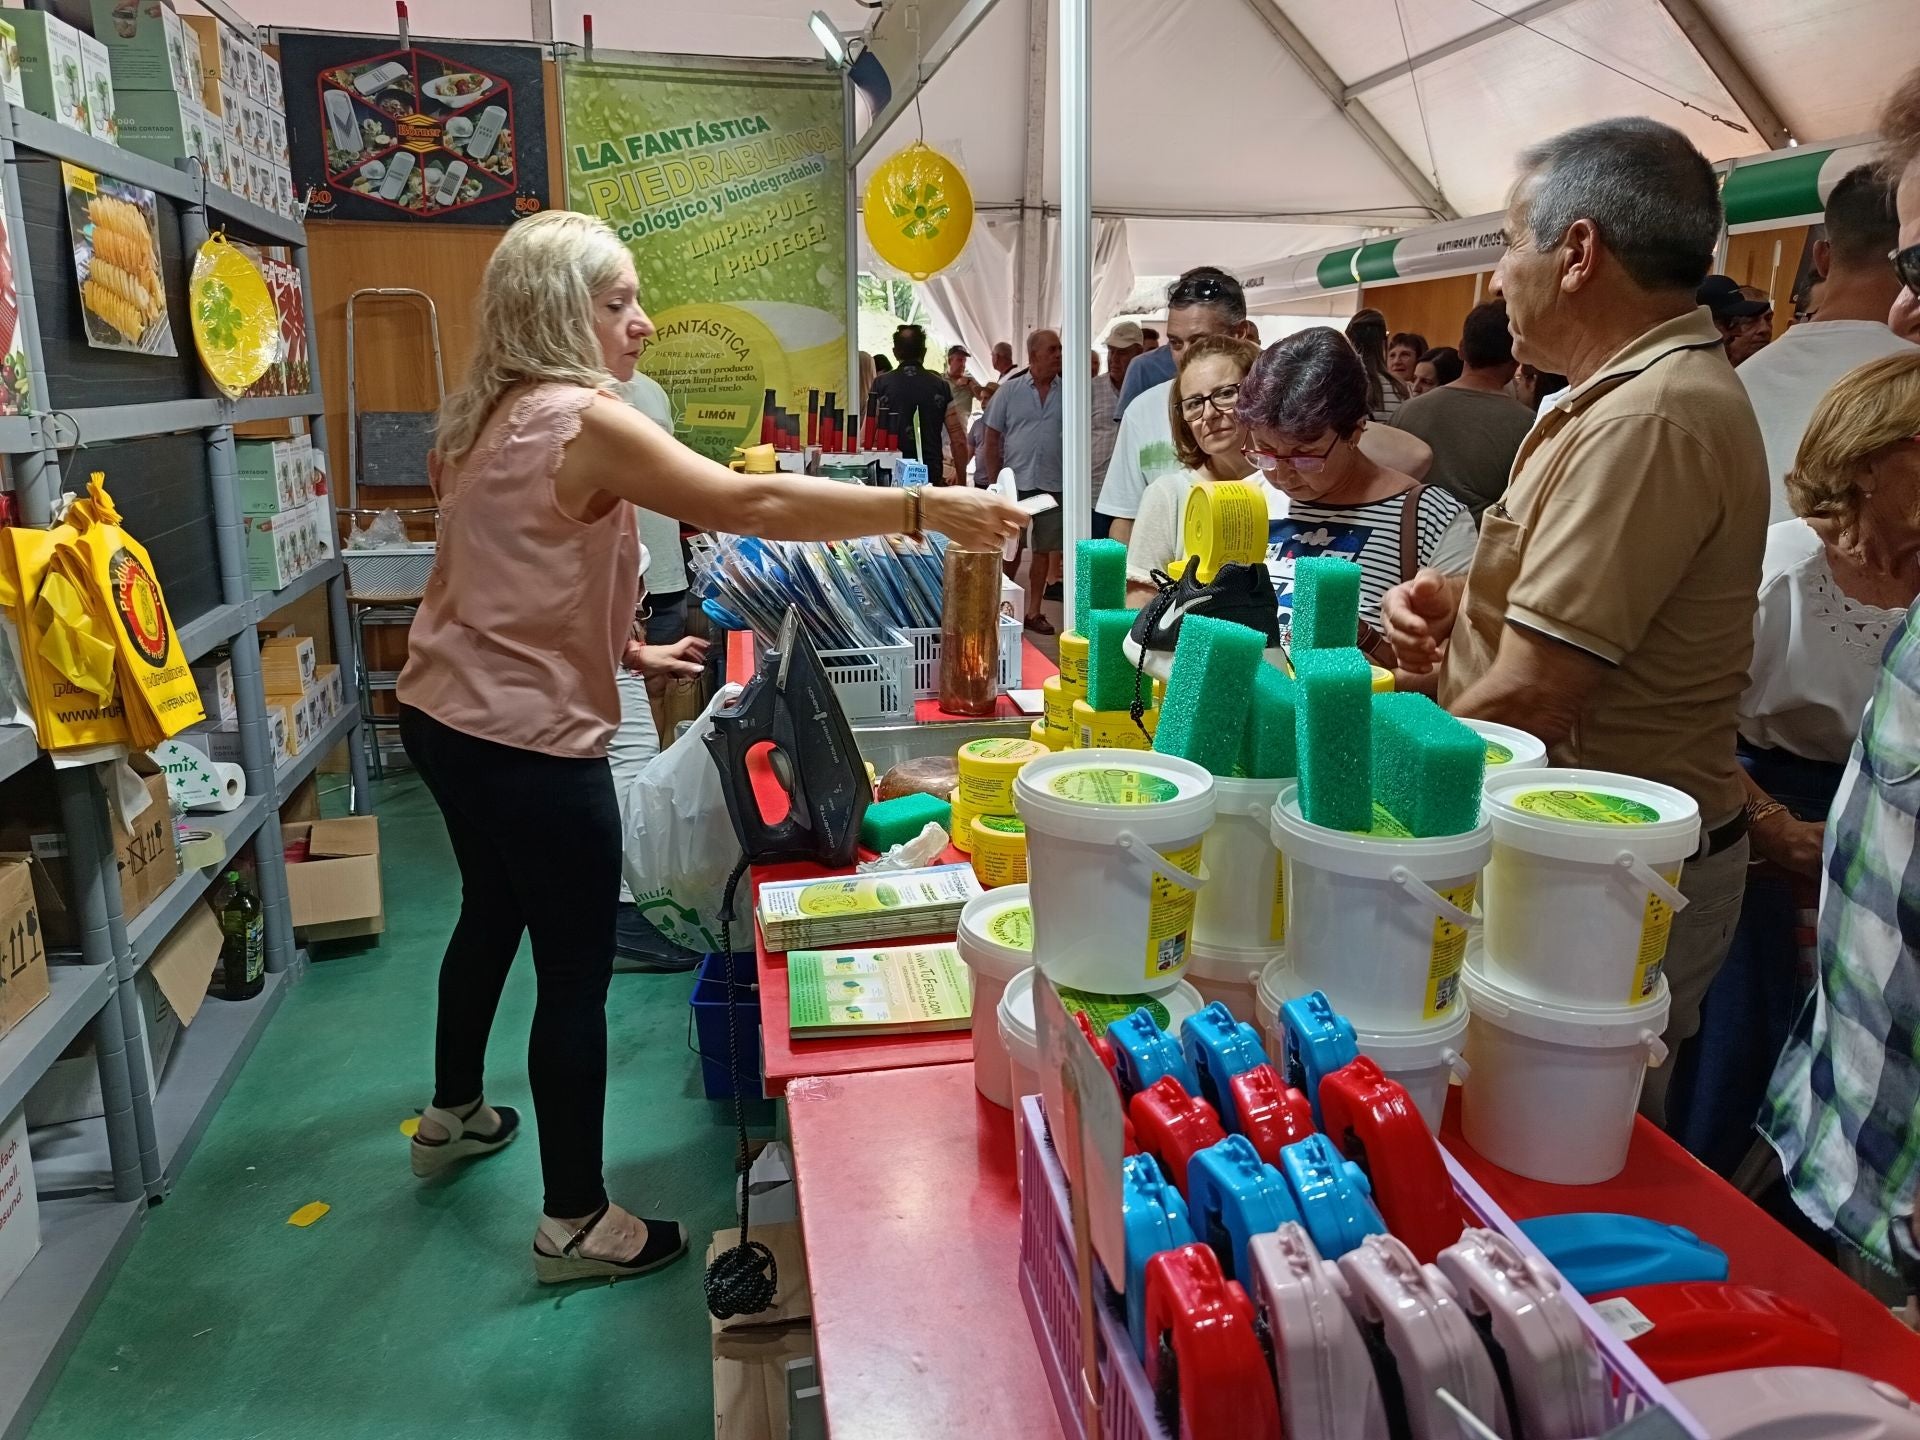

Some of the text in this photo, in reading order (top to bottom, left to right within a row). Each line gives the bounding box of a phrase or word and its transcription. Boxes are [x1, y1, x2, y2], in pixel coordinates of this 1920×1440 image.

[398, 124, 440, 137] Börner
[575, 115, 771, 172] LA FANTÁSTICA
[588, 126, 842, 221] PIEDRABLANCA
[311, 190, 332, 204] 50
[515, 197, 540, 211] 50
[617, 160, 823, 243] cológico y biodegradable
[728, 223, 829, 280] PROTEGE!
[656, 319, 751, 362] FANTÁSTICA
[659, 368, 686, 376] Blanca
[714, 364, 754, 375] producto
[672, 379, 691, 387] para
[693, 375, 734, 386] limpiarlo
[735, 373, 758, 382] todo,
[684, 386, 706, 394] hasta
[708, 384, 717, 393] el
[718, 384, 744, 392] suelo.
[697, 408, 736, 421] LIMÓN
[634, 886, 673, 903] UTILIZA
